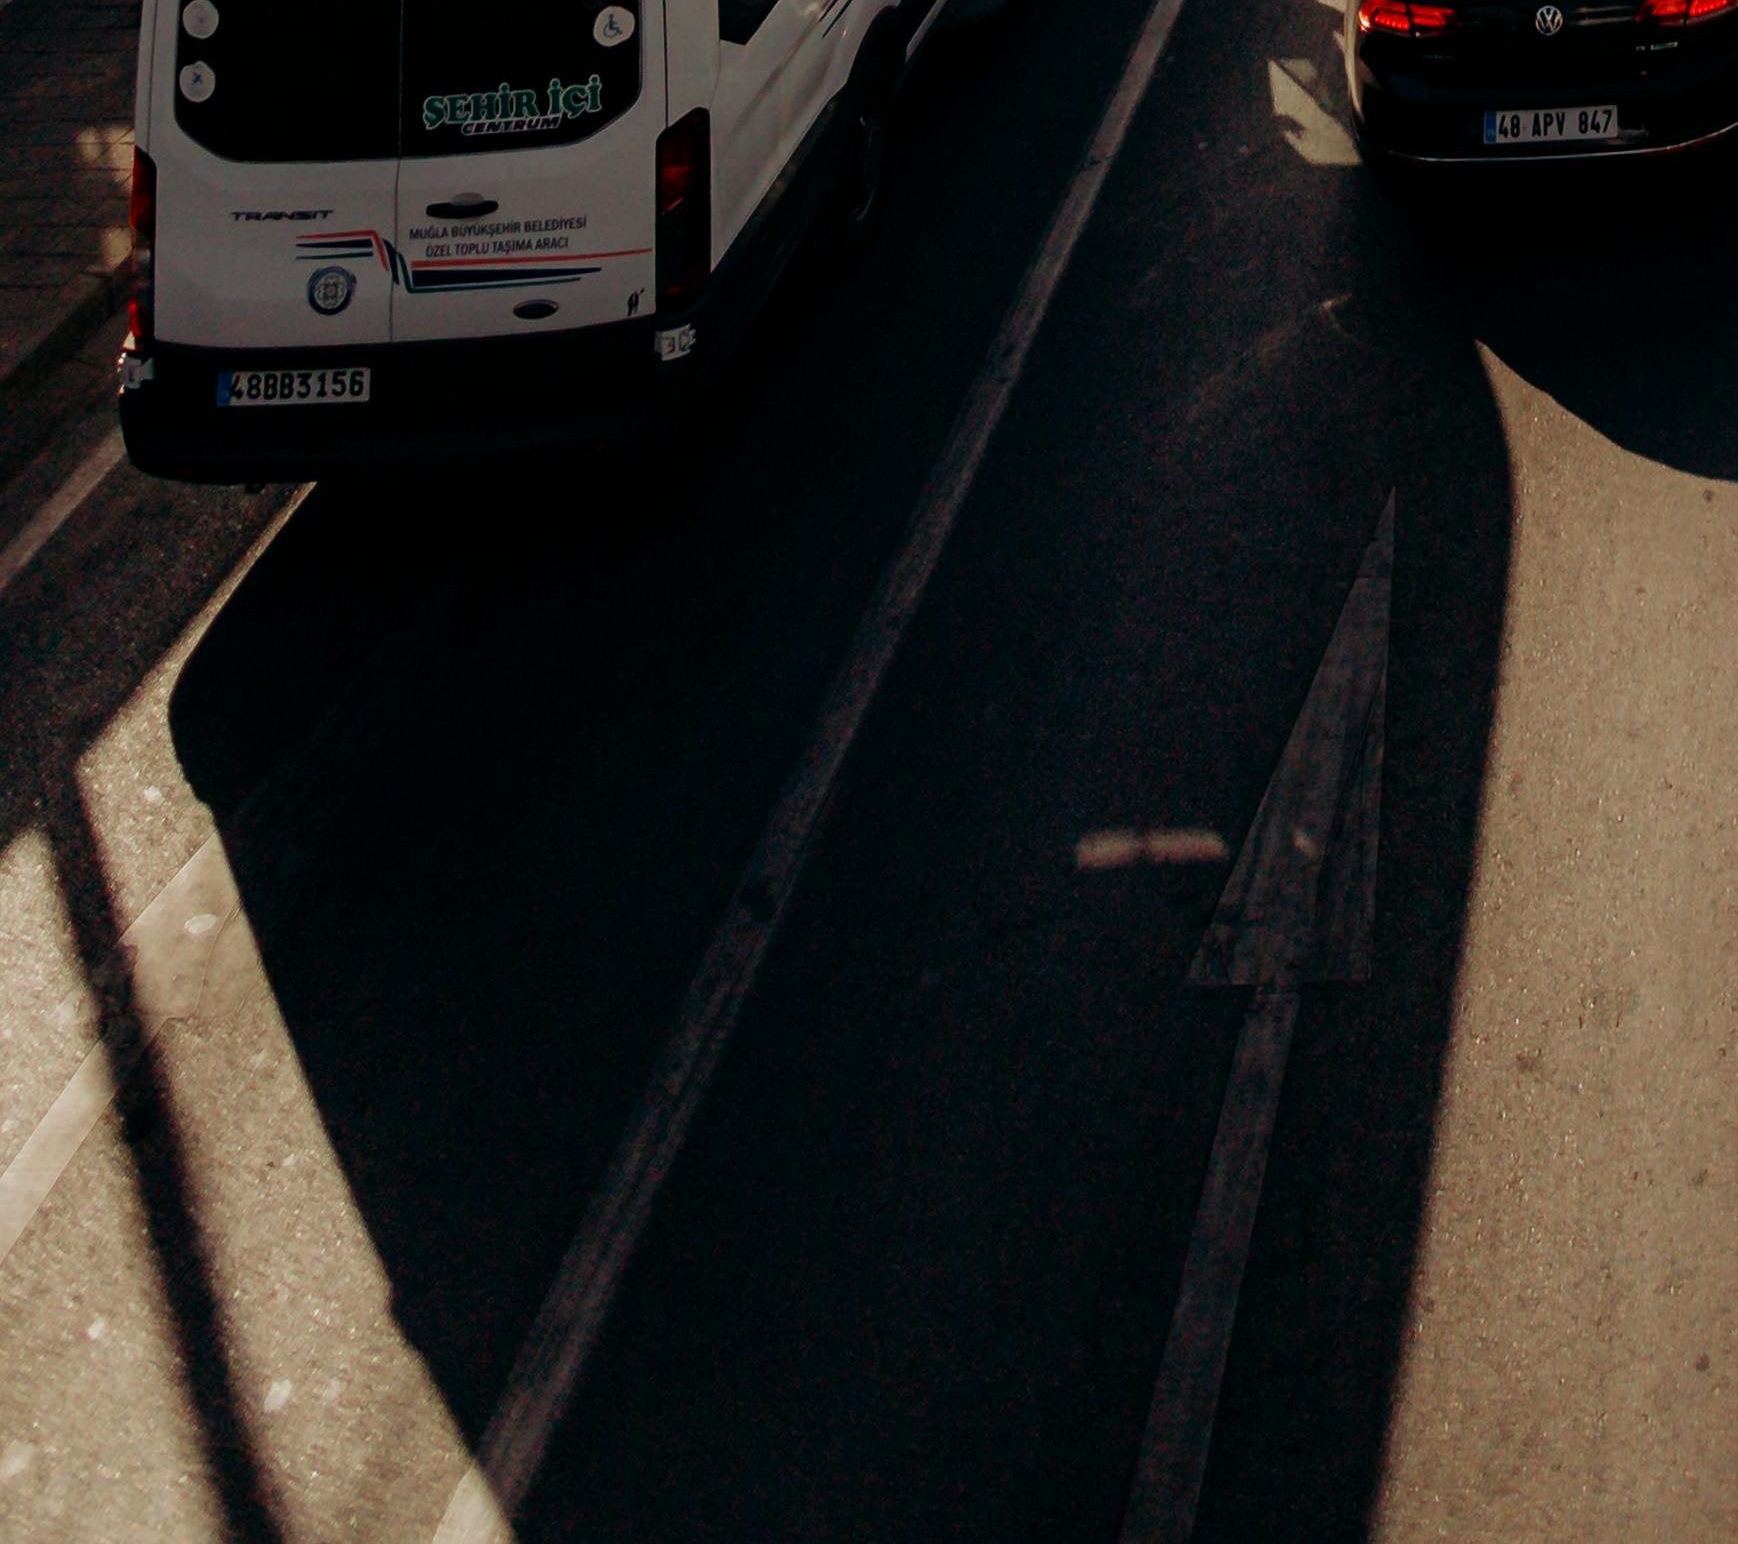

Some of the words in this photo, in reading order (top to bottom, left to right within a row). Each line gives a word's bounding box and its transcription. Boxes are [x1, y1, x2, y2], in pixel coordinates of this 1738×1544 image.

[422, 81, 541, 131] ŞEHİR
[547, 73, 603, 120] İÇİ
[461, 116, 562, 137] CENTRUM
[1498, 115, 1521, 138] 48
[1531, 112, 1566, 137] APV
[1578, 109, 1613, 134] 847
[230, 209, 335, 222] TRANSIT
[409, 225, 449, 240] MUĞLA
[451, 219, 521, 238] BÜYÜKŞEHİR
[524, 216, 588, 234] BELEDİYESİ
[425, 243, 452, 258] ÖZEL
[455, 242, 490, 256] TOPLU
[492, 239, 533, 255] TAŞIMA
[535, 236, 569, 250] ARACI
[230, 370, 366, 401] 48BB3156
